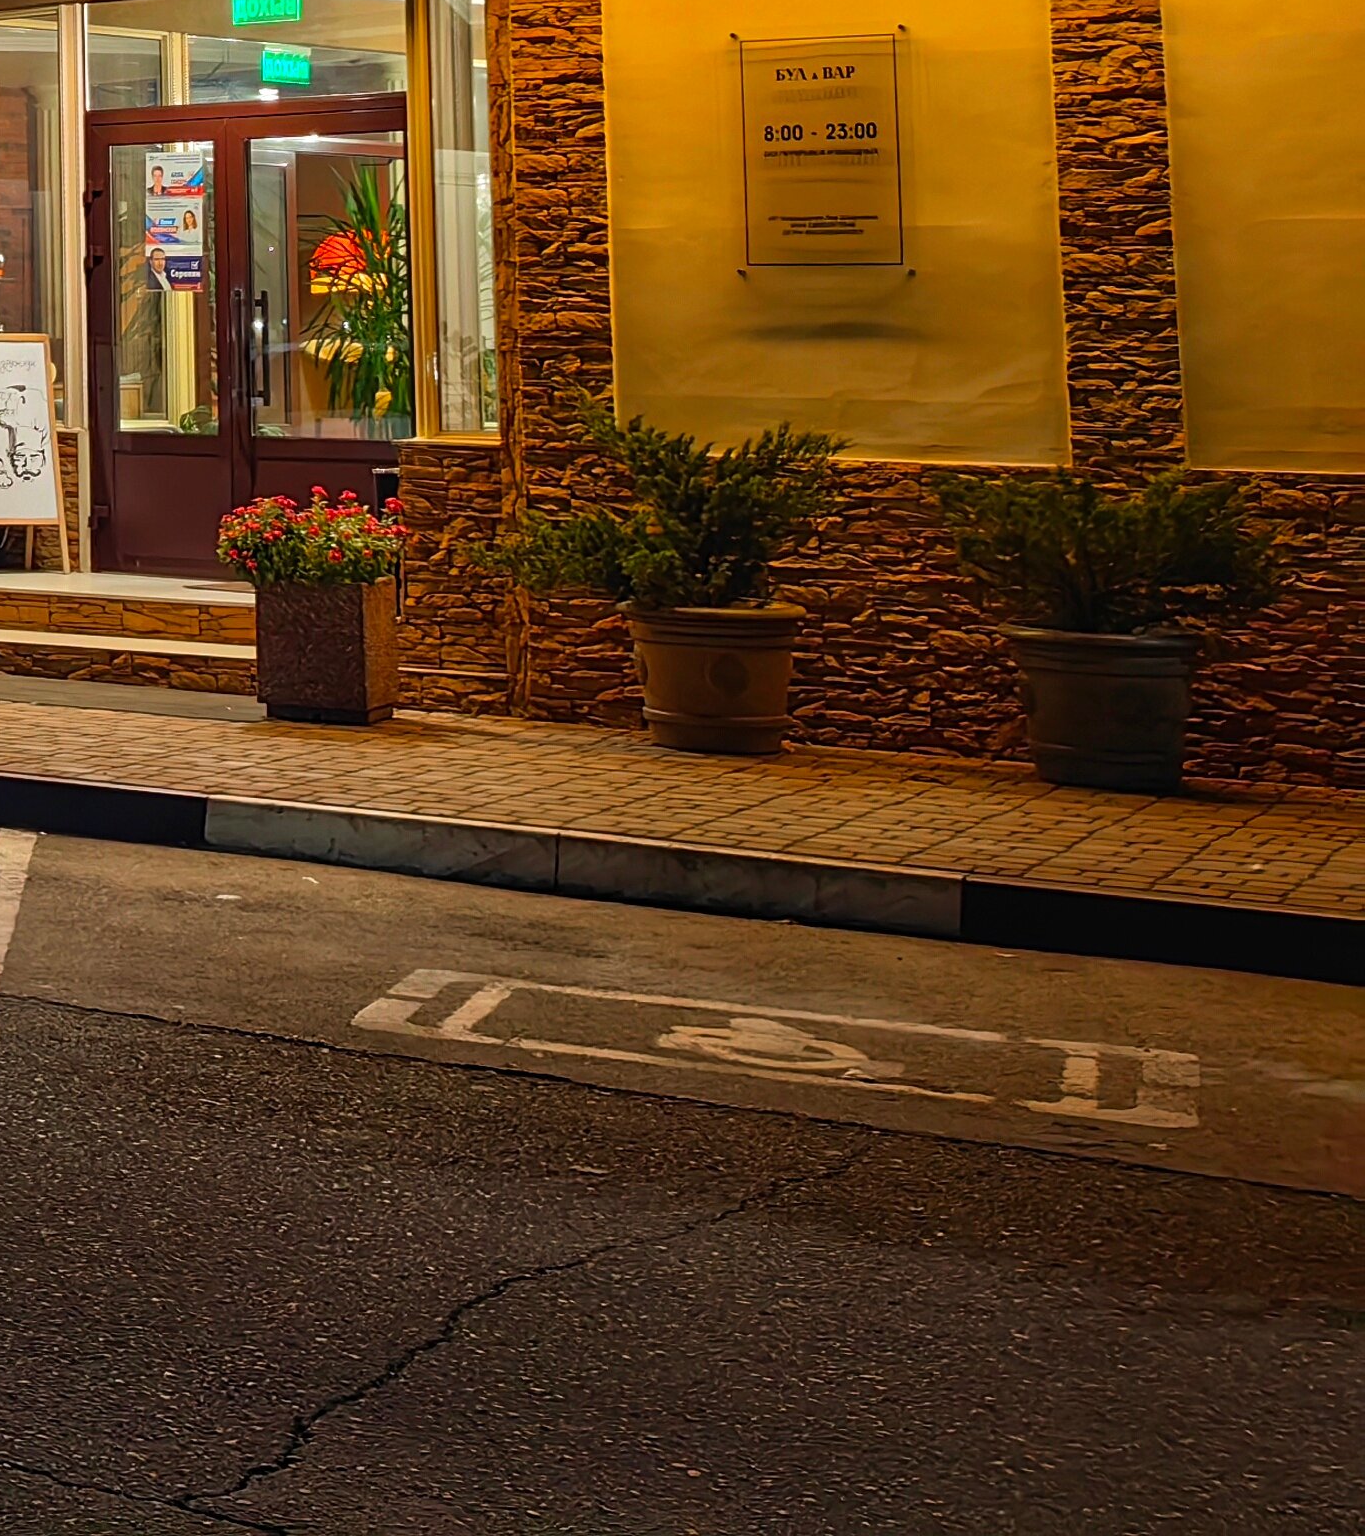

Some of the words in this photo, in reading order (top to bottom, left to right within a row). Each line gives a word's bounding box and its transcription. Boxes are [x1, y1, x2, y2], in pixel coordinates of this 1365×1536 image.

[776, 68, 807, 81] БУЛ
[823, 66, 855, 79] ВАР
[764, 125, 803, 142] 8:00
[826, 122, 878, 140] 23:00
